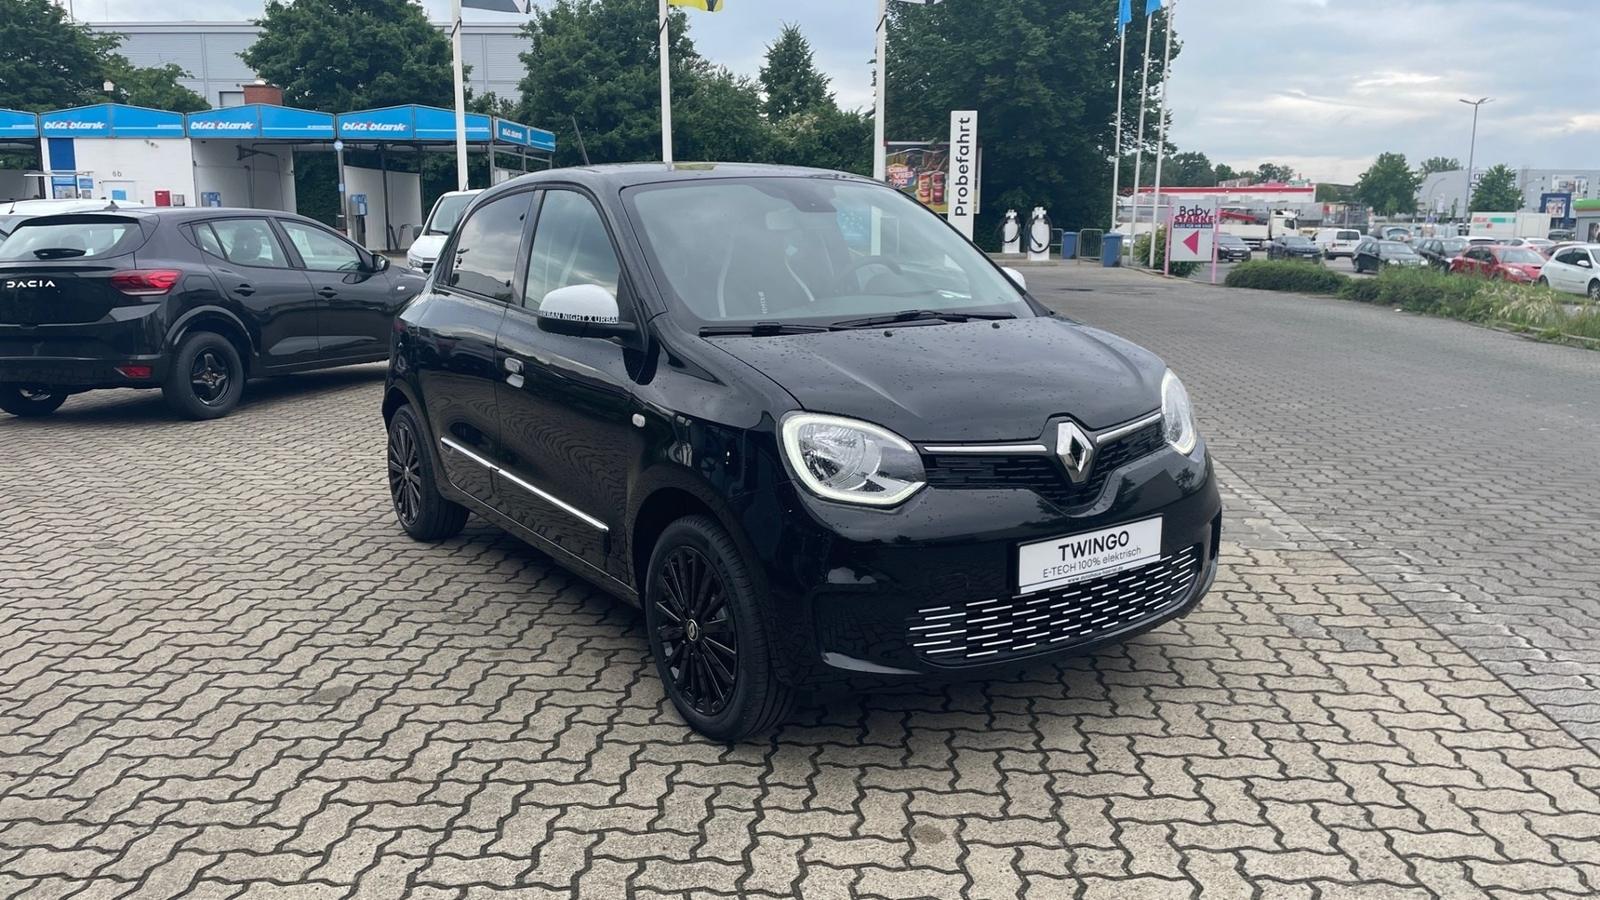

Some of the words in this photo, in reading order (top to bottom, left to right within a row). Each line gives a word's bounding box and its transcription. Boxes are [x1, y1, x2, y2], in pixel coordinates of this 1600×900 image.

[368, 122, 406, 131] blank
[954, 117, 970, 216] Probefahrt
[1179, 204, 1211, 218] Baby
[6, 280, 55, 288] DACIA
[562, 313, 585, 322] NIGHT
[595, 316, 618, 324] URBA
[1058, 531, 1129, 561] TWINGO
[1043, 563, 1076, 578] E-TECH
[1078, 557, 1101, 571] 100%
[1102, 546, 1142, 564] elektrisch
